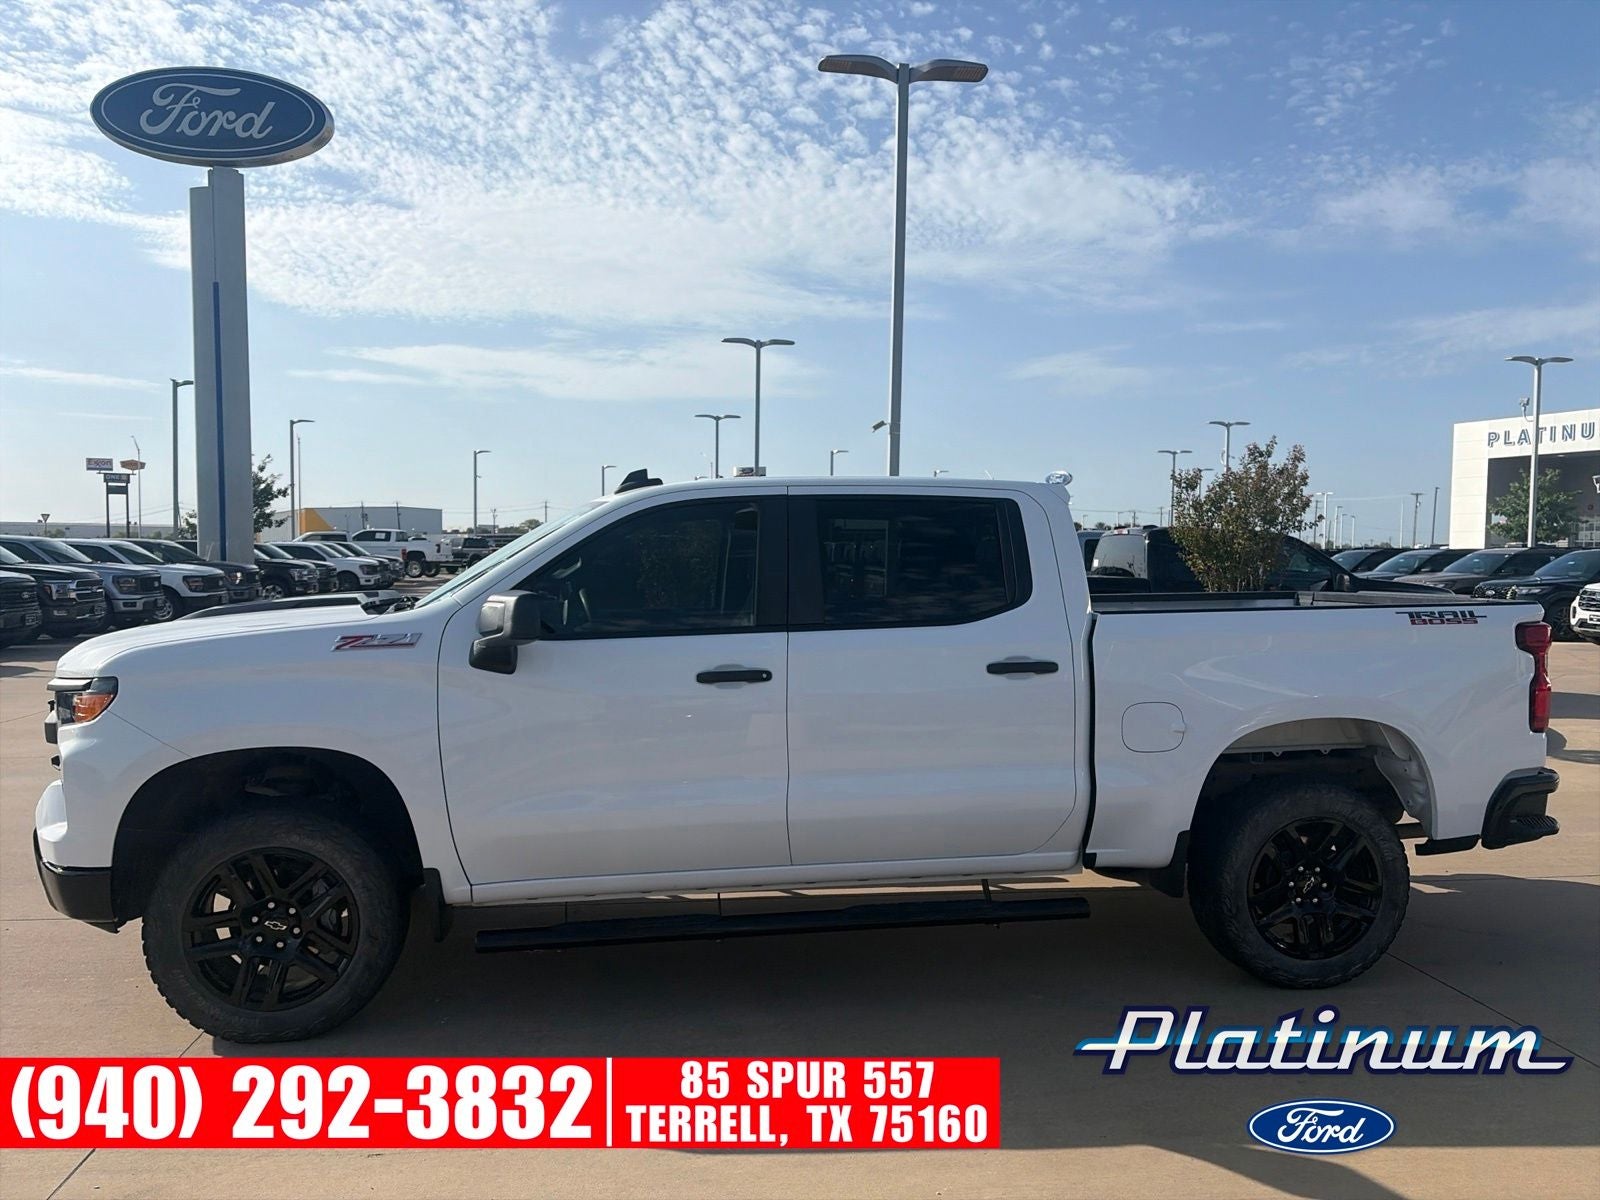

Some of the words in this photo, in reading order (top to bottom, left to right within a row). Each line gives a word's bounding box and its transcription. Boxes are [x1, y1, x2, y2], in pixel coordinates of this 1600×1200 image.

[139, 83, 275, 139] Ford
[1487, 421, 1600, 447] PLATINU
[330, 632, 422, 652] Z71
